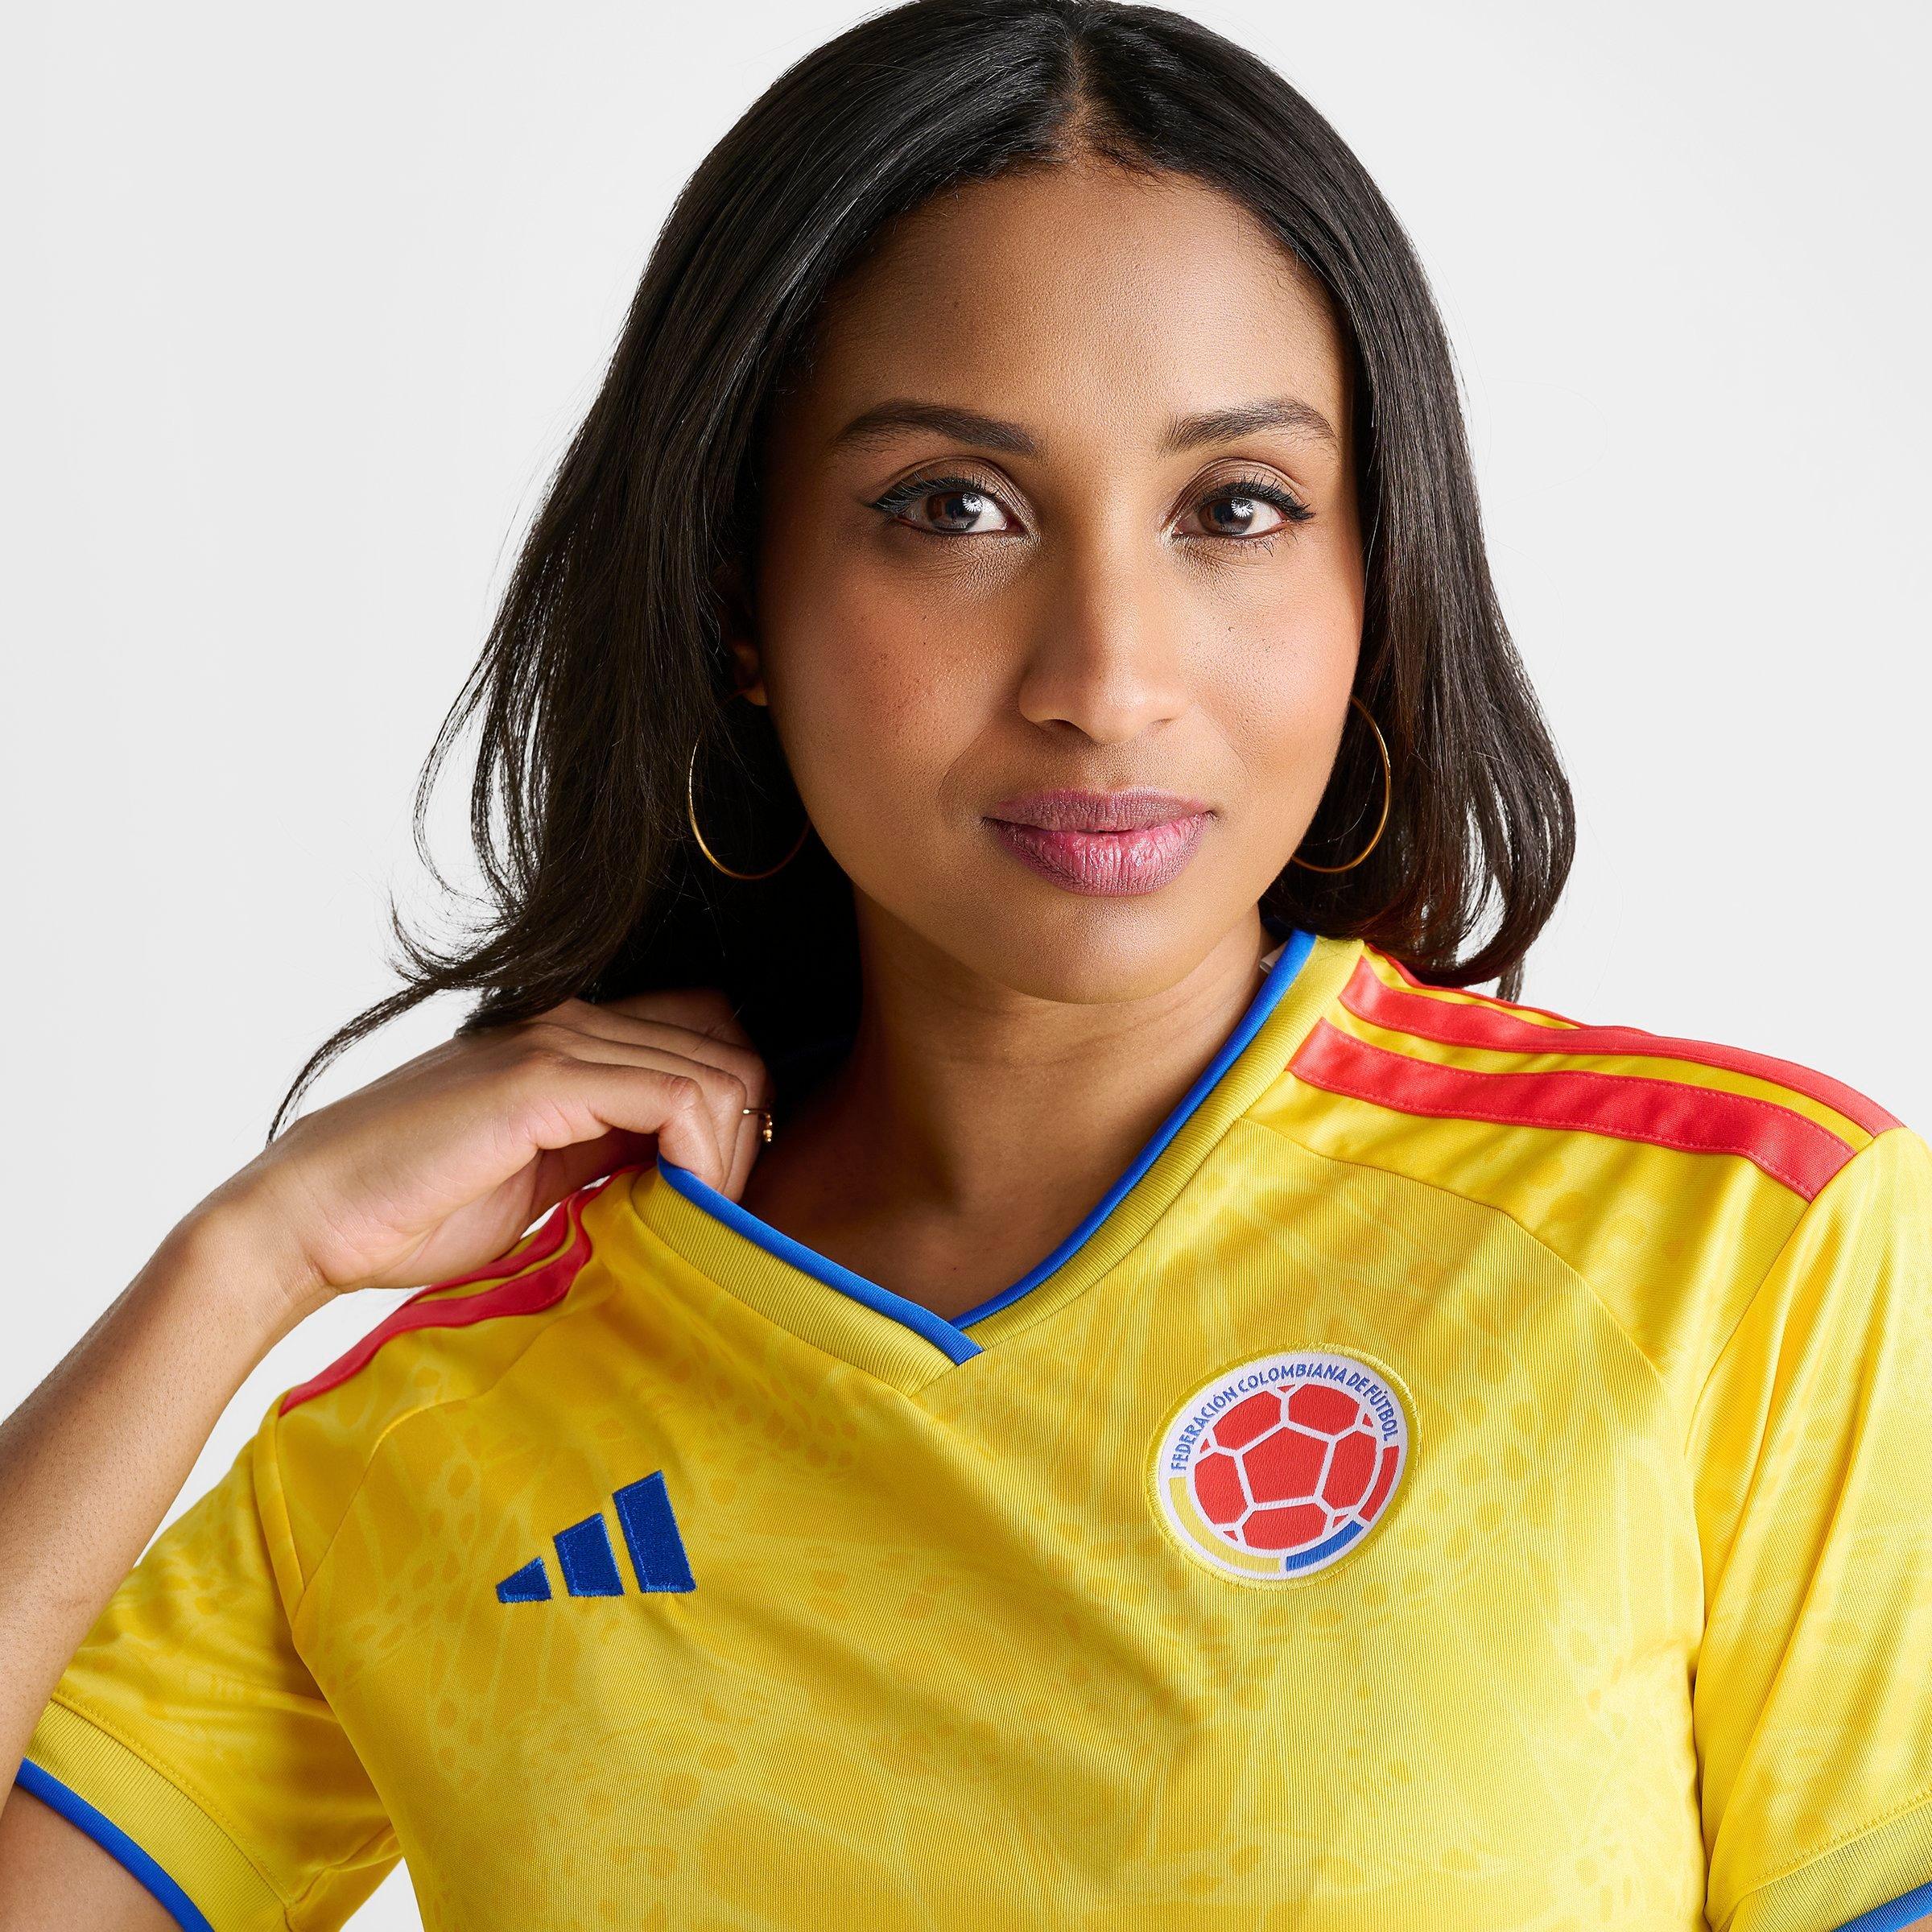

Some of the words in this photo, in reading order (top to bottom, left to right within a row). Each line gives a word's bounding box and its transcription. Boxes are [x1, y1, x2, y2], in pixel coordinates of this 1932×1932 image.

[1170, 1386, 1238, 1471] FEDERACIÓN
[1238, 1363, 1346, 1393] COLOMBIANA
[1346, 1373, 1369, 1393] DE
[1363, 1385, 1398, 1441] FÚTBOL
